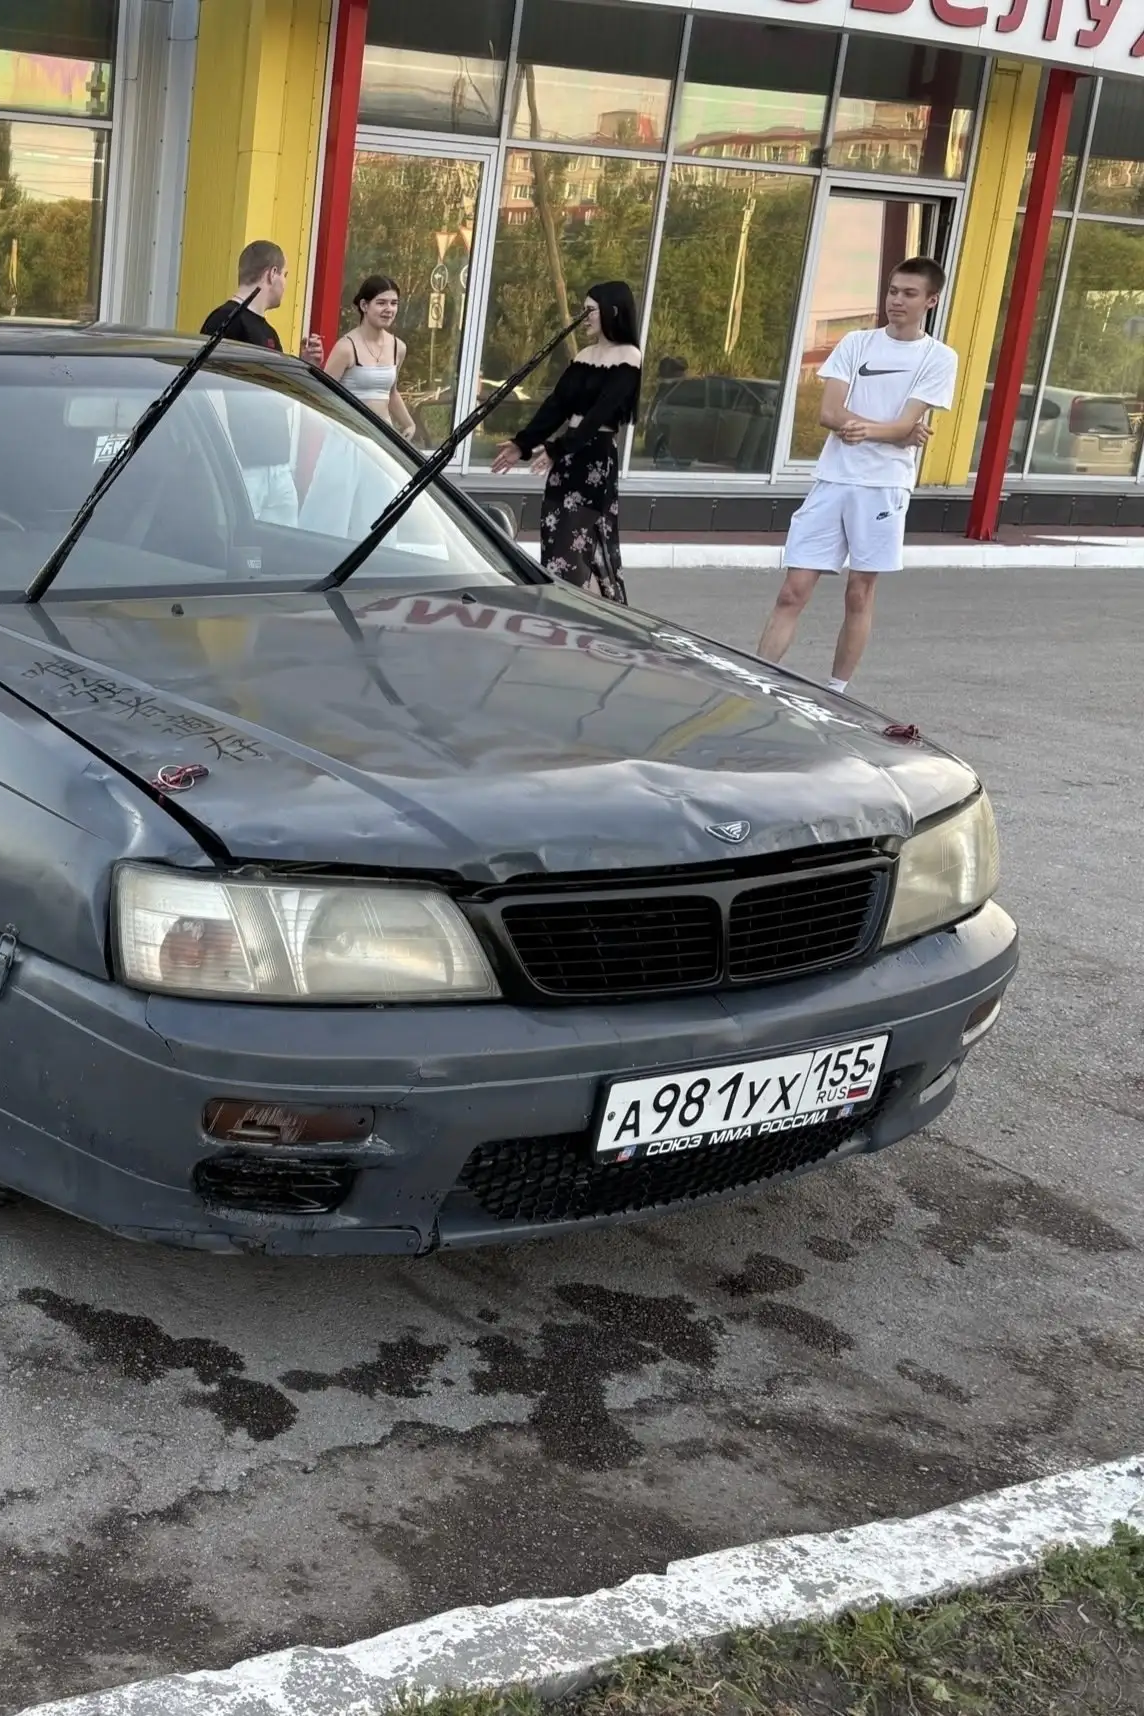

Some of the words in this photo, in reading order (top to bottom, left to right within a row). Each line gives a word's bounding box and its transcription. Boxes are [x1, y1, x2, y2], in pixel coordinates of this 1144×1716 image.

[813, 1043, 875, 1091] 155
[816, 1085, 848, 1105] RUS
[646, 1134, 703, 1157] СОЮЗ
[757, 1109, 829, 1136] РОССИИ
